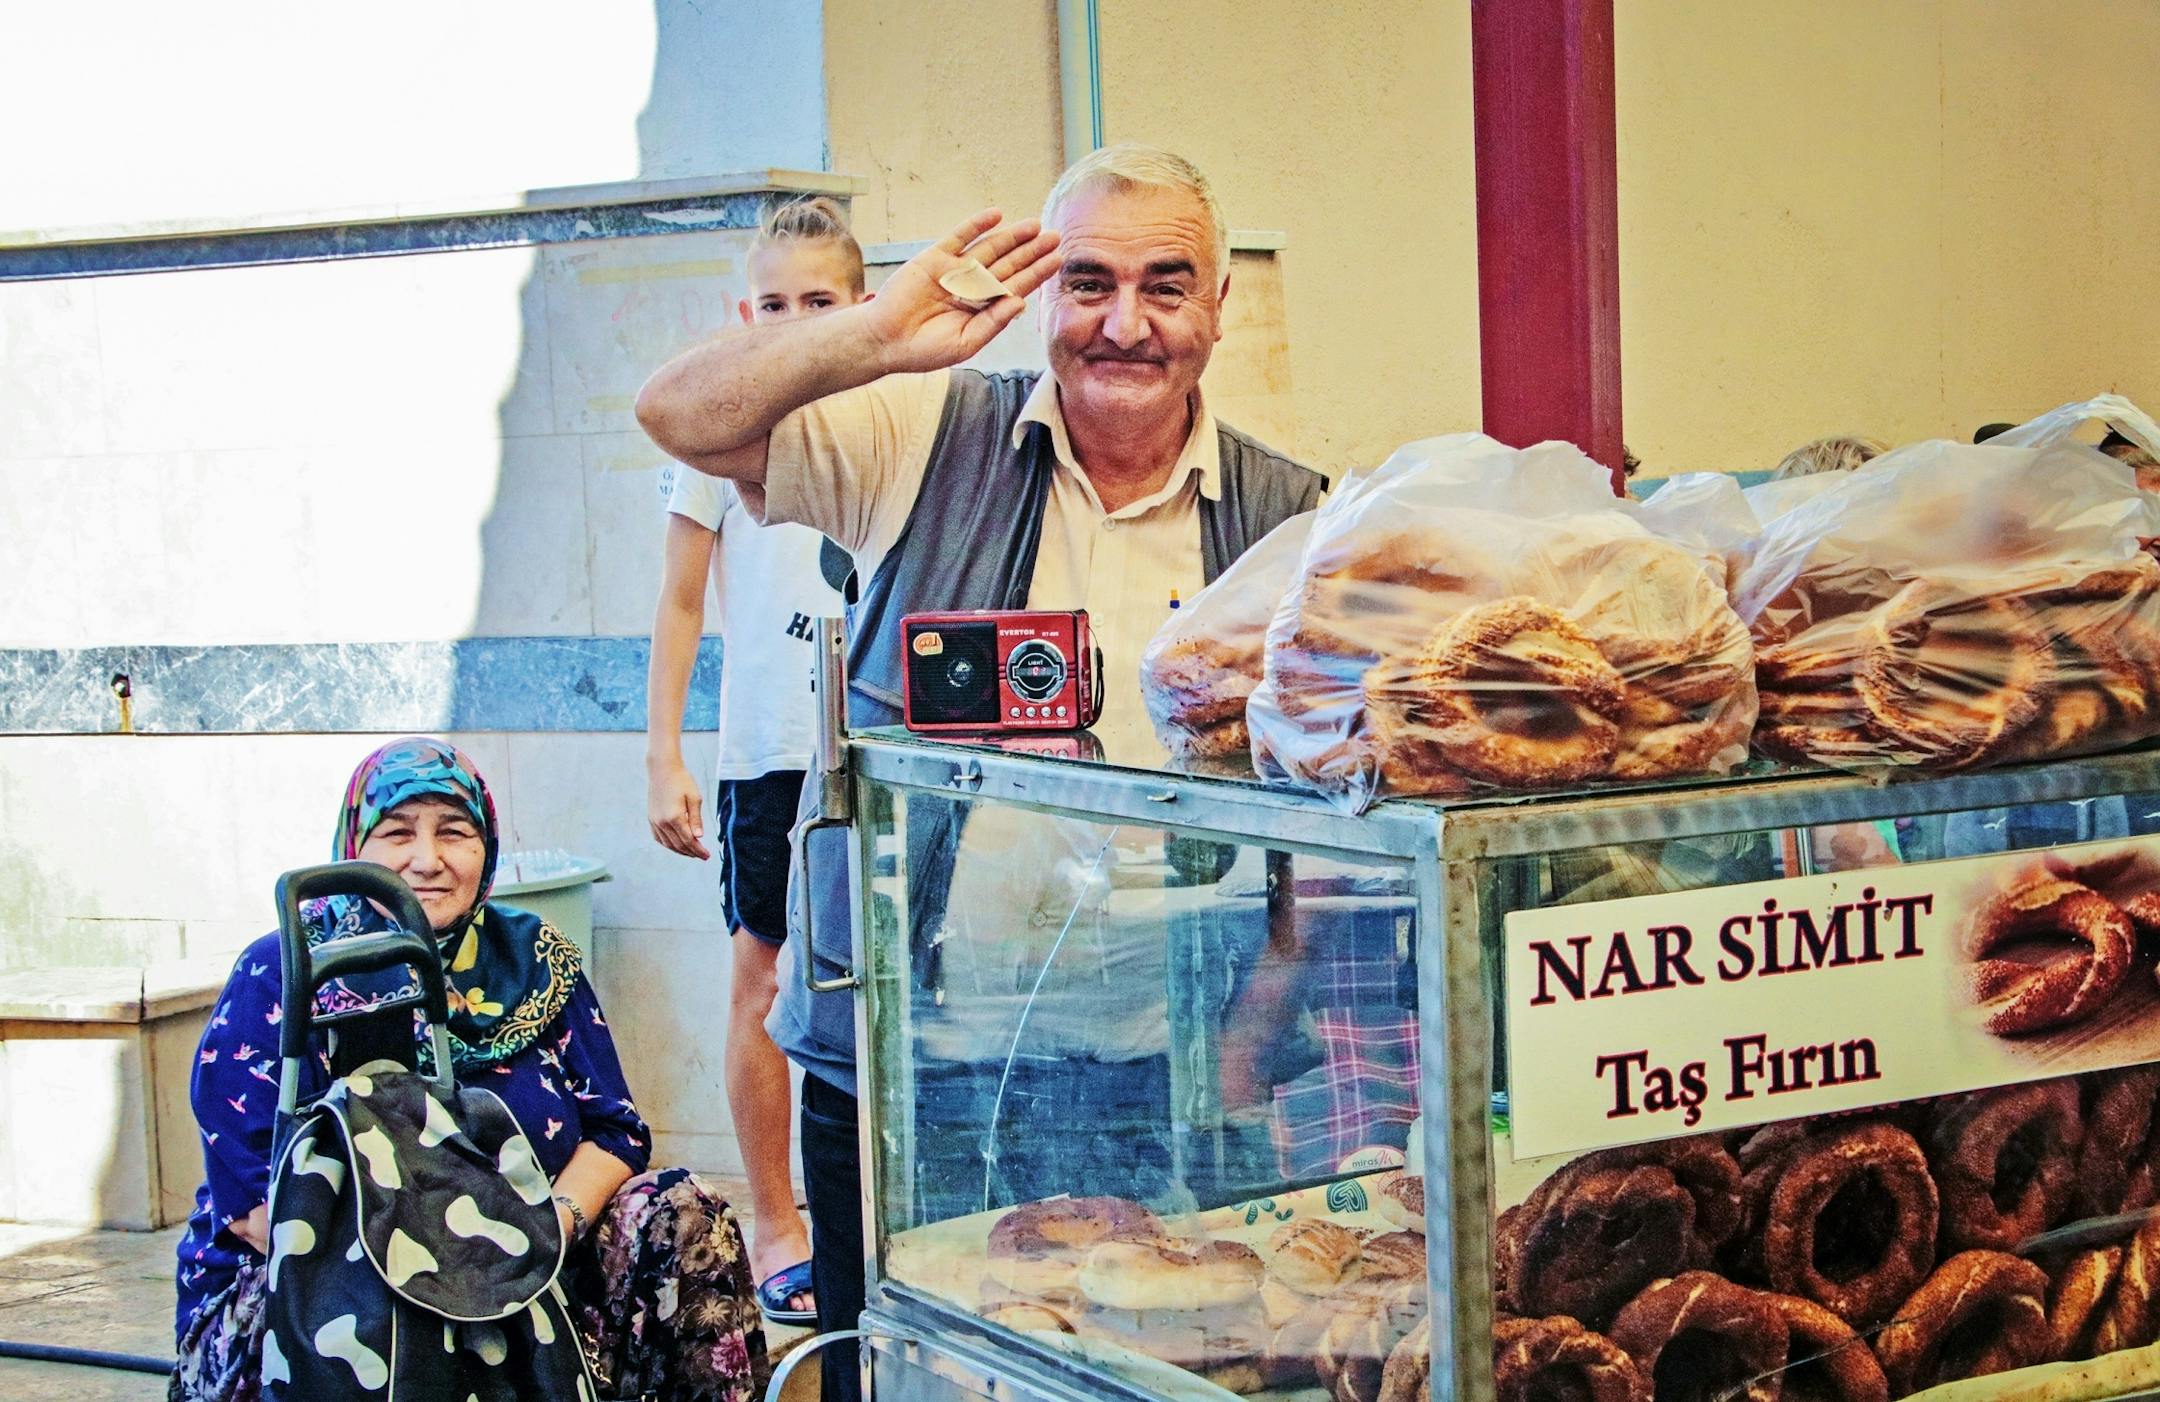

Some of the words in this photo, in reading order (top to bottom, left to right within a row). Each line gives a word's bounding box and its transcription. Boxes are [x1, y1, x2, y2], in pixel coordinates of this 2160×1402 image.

[1529, 924, 1705, 1007] NAR
[1716, 886, 1935, 982] SİMİT
[1595, 1049, 1708, 1128] Taş
[1723, 1032, 1882, 1103] Fırın
